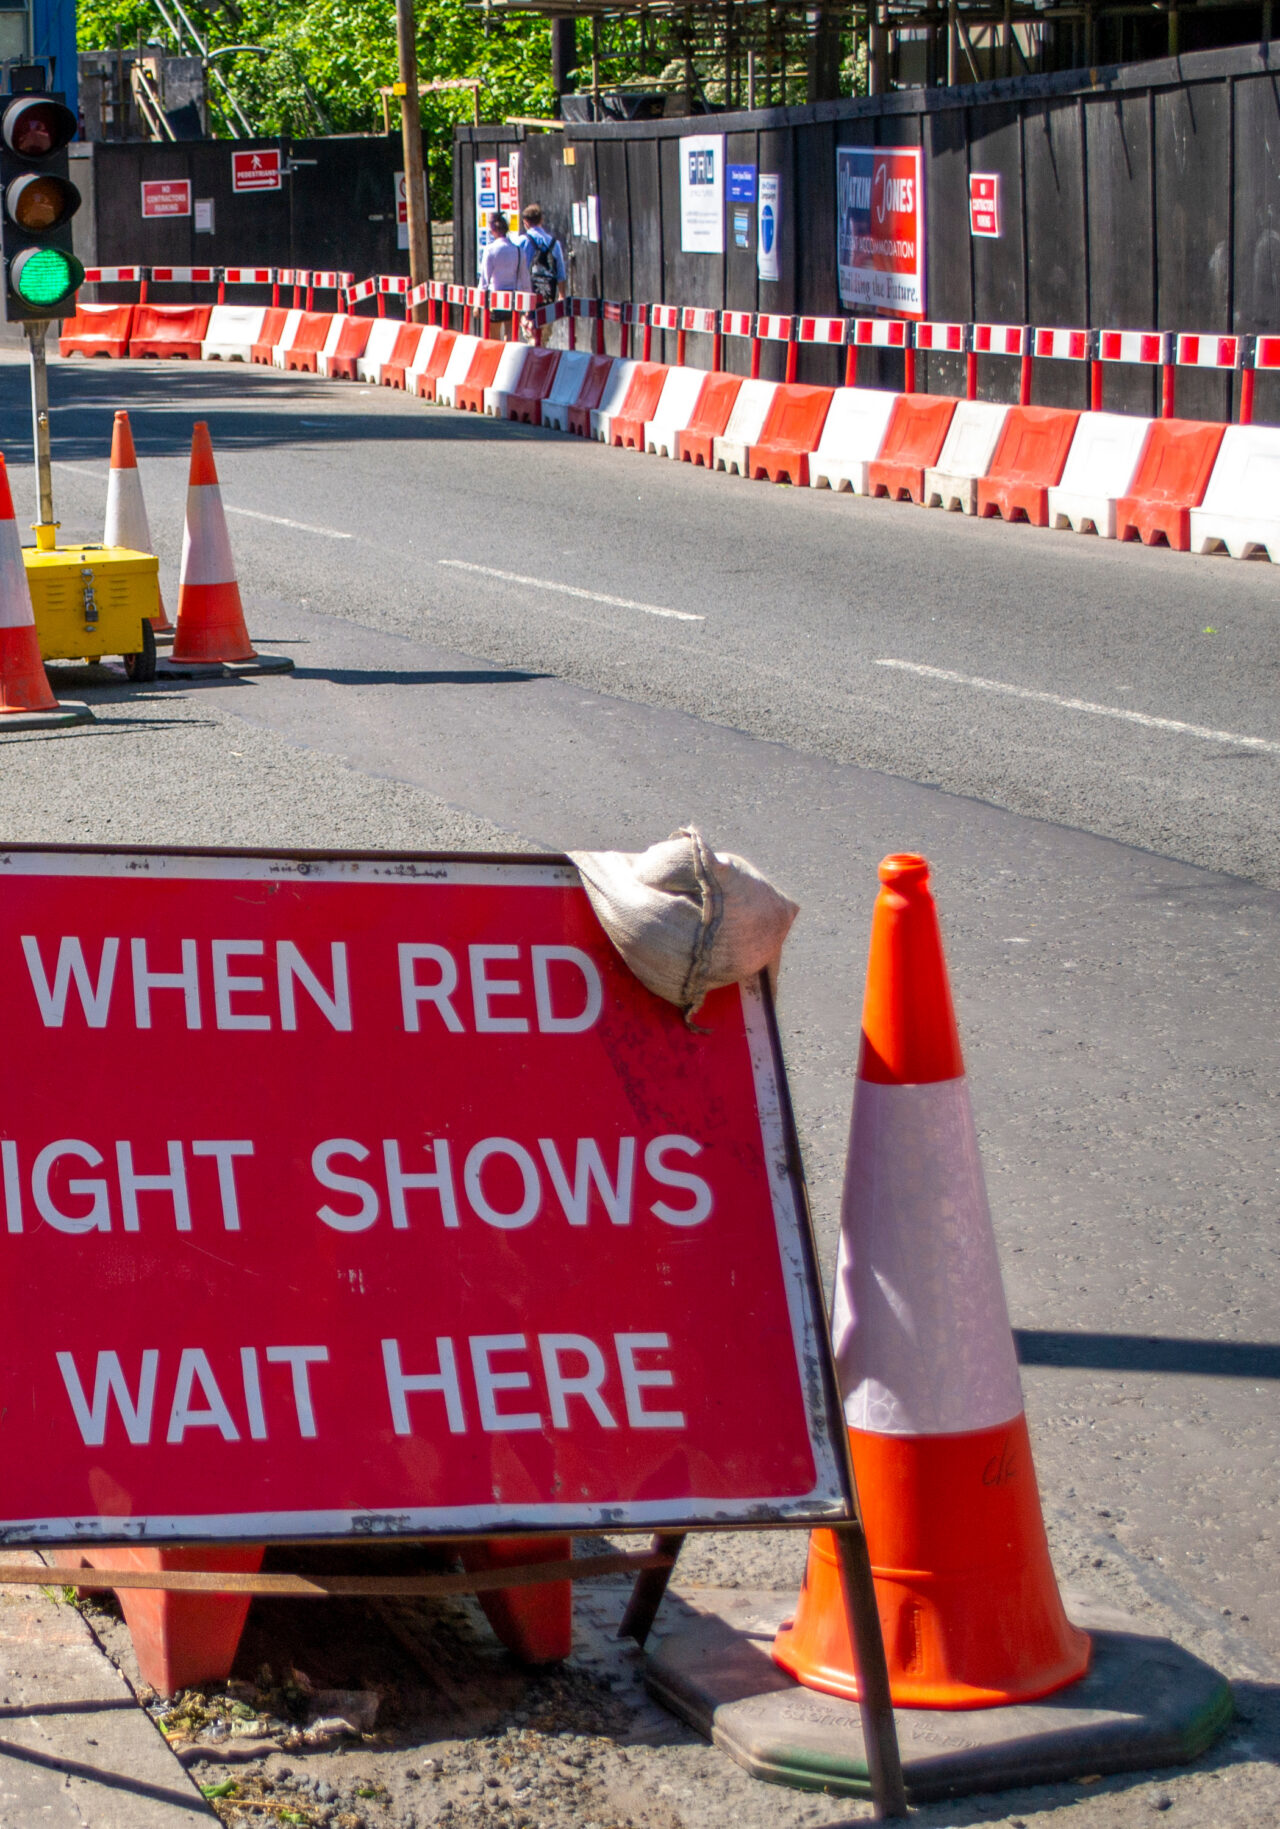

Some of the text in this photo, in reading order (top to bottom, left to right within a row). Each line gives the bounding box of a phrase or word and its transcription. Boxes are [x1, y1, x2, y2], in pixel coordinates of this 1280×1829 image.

[147, 194, 186, 204] CONTRACTORS
[161, 185, 170, 193] NO
[875, 163, 913, 223] JONES
[154, 203, 179, 211] PARKING
[860, 236, 914, 258] ACCOMMODATION
[840, 270, 918, 302] Building the Future.
[20, 935, 603, 1034] WHEN RED
[311, 1134, 713, 1232] SHOWS
[55, 1332, 686, 1446] WAIT HERE
